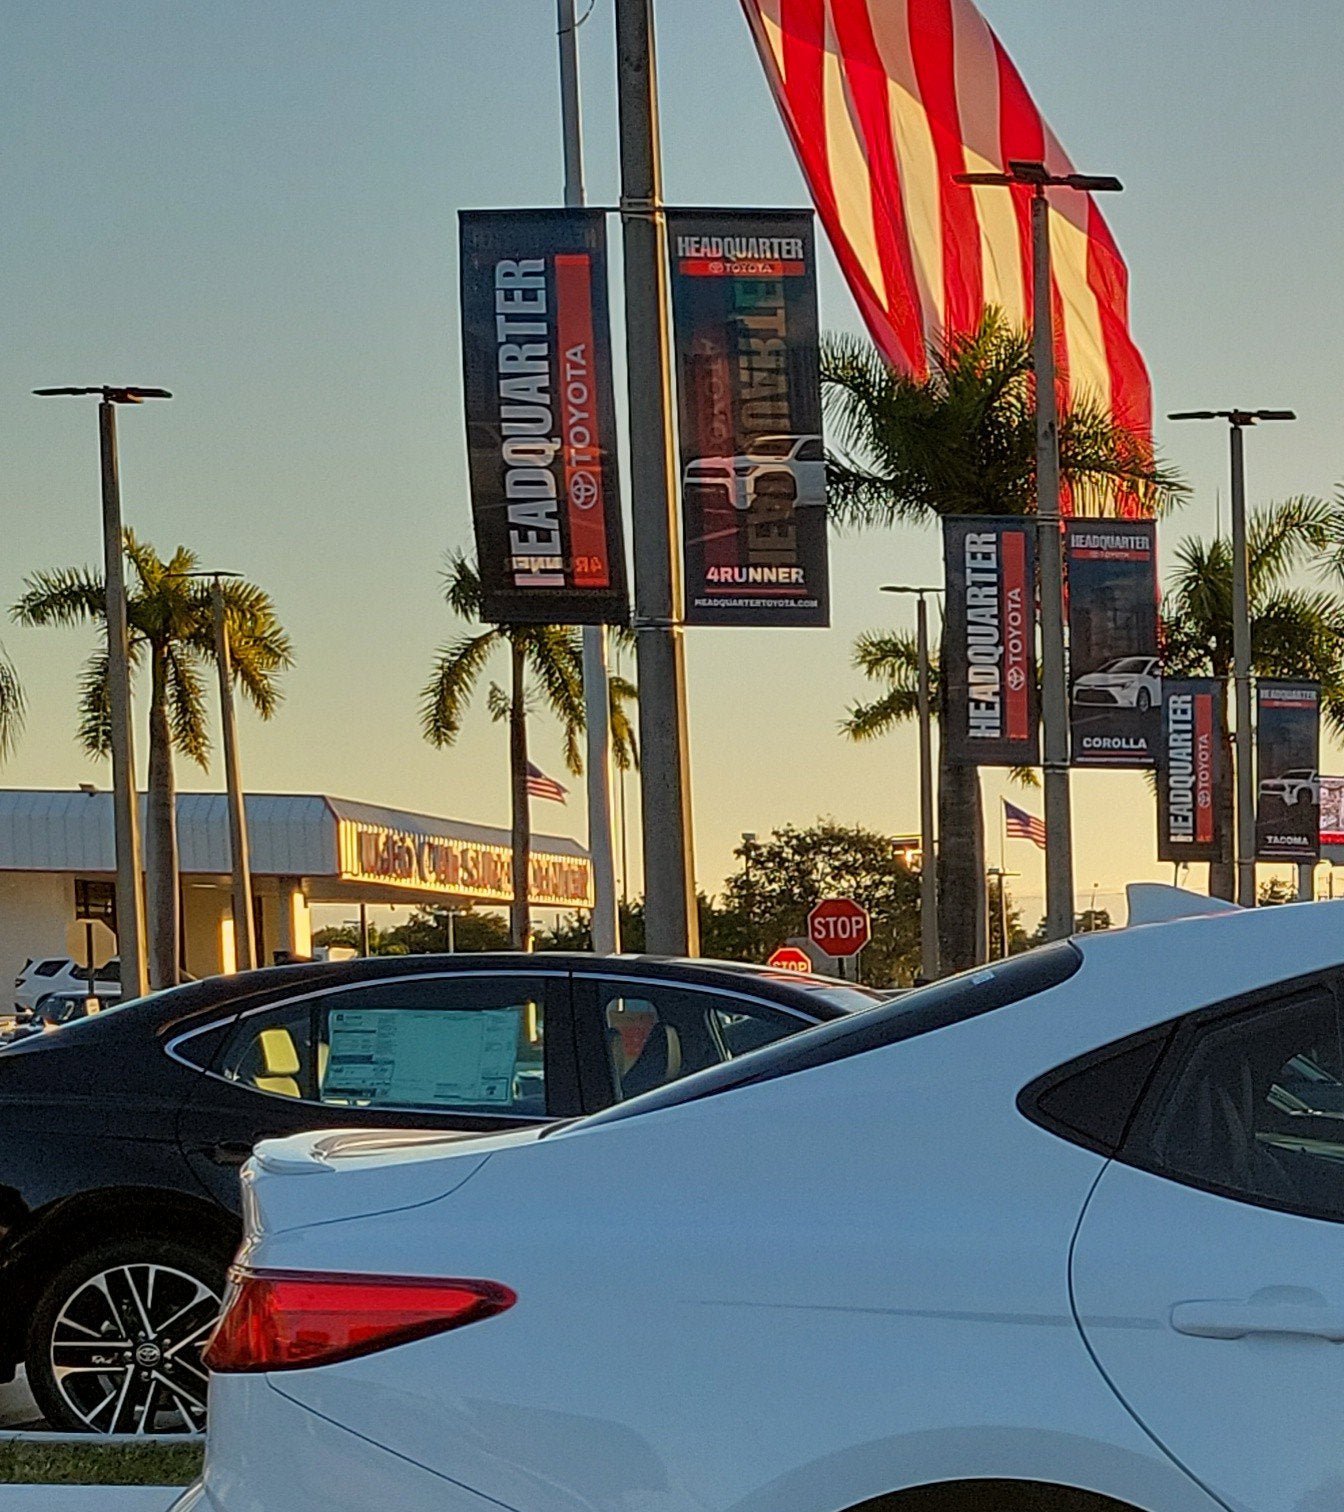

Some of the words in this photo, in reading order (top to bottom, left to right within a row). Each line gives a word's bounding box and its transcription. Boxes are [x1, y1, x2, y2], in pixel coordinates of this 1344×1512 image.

[677, 236, 804, 261] HEADQUARTER
[724, 262, 772, 273] TOYOTA
[565, 343, 592, 467] TOYOTA
[495, 258, 565, 588] HEADQUARTER
[1071, 534, 1149, 550] HEADQUARTER
[706, 567, 804, 583] 4RUNNER
[965, 532, 1004, 738] HEADQUARTER
[1008, 587, 1022, 664] TOYOTA
[1082, 737, 1148, 750] COROLLA
[1169, 694, 1196, 843] HEADQUARTER
[1197, 734, 1210, 789] TOYOTA
[1265, 835, 1309, 846] TACOMA
[813, 916, 865, 939] STOP
